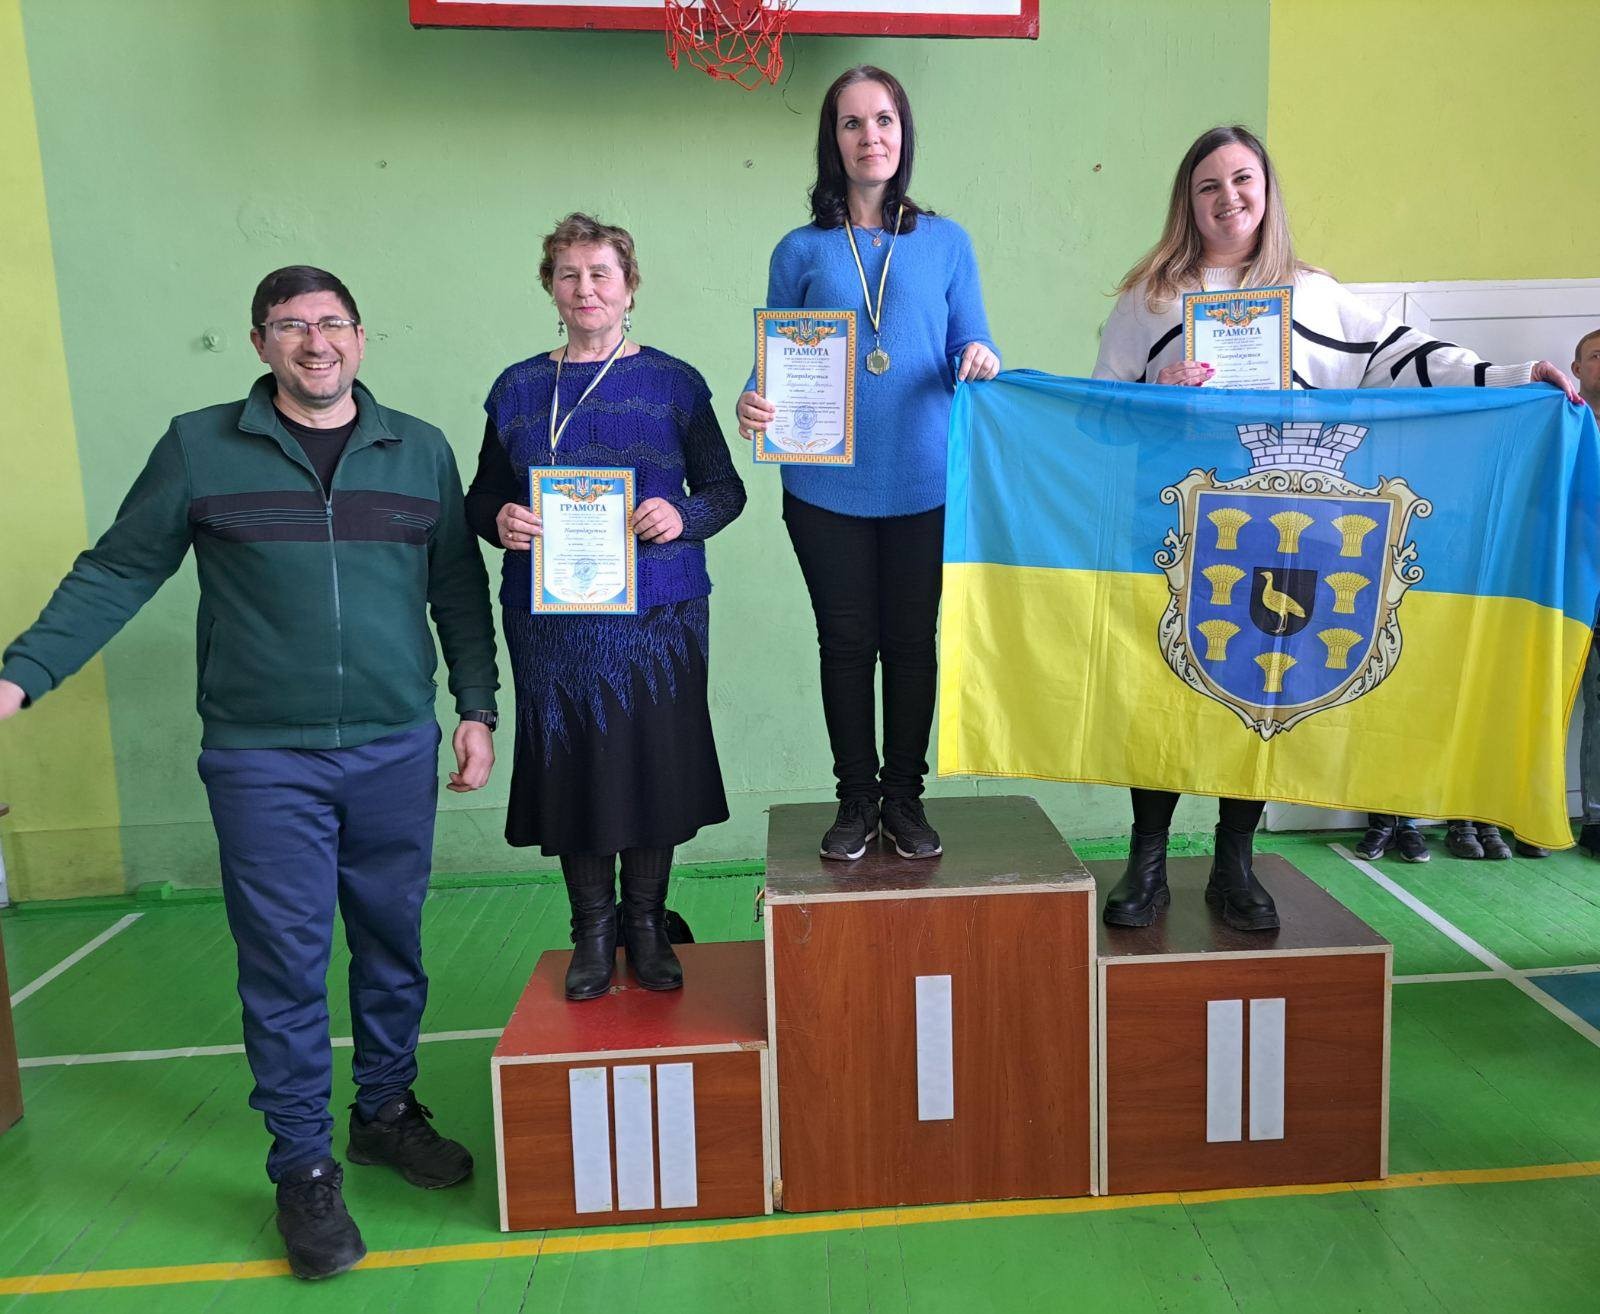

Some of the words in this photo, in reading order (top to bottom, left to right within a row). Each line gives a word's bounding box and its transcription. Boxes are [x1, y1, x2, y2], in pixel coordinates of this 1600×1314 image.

[1212, 327, 1262, 338] ГРАМОТА
[784, 347, 829, 356] ГРАМОТА
[560, 503, 607, 512] ГРАМОТА
